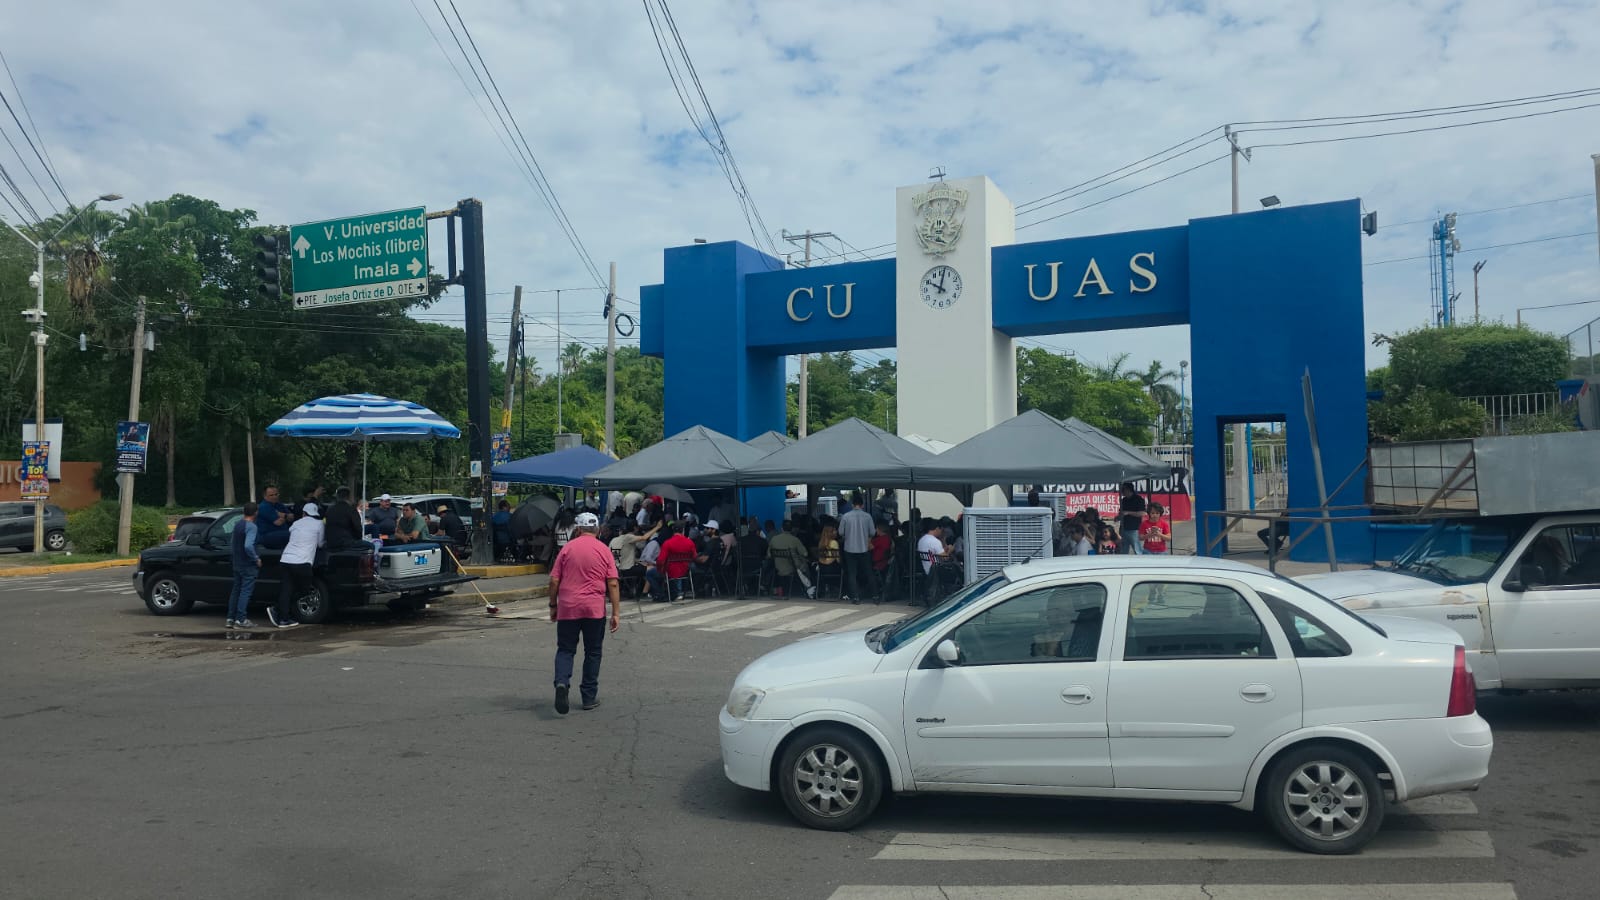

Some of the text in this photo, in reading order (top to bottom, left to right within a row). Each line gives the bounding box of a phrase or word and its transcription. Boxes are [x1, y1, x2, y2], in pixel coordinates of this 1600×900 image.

[324, 213, 424, 241] V. Universidad
[313, 235, 425, 265] Los Mochis (libre)
[354, 261, 400, 280] Imala
[1023, 252, 1159, 302] UAS
[323, 290, 350, 304] Josefa
[353, 287, 372, 300] Ortiz
[373, 286, 385, 298] de
[387, 285, 396, 297] D.
[1070, 495, 1091, 505] HASTA
[1093, 494, 1107, 504] QUE
[1108, 494, 1116, 504] SE
